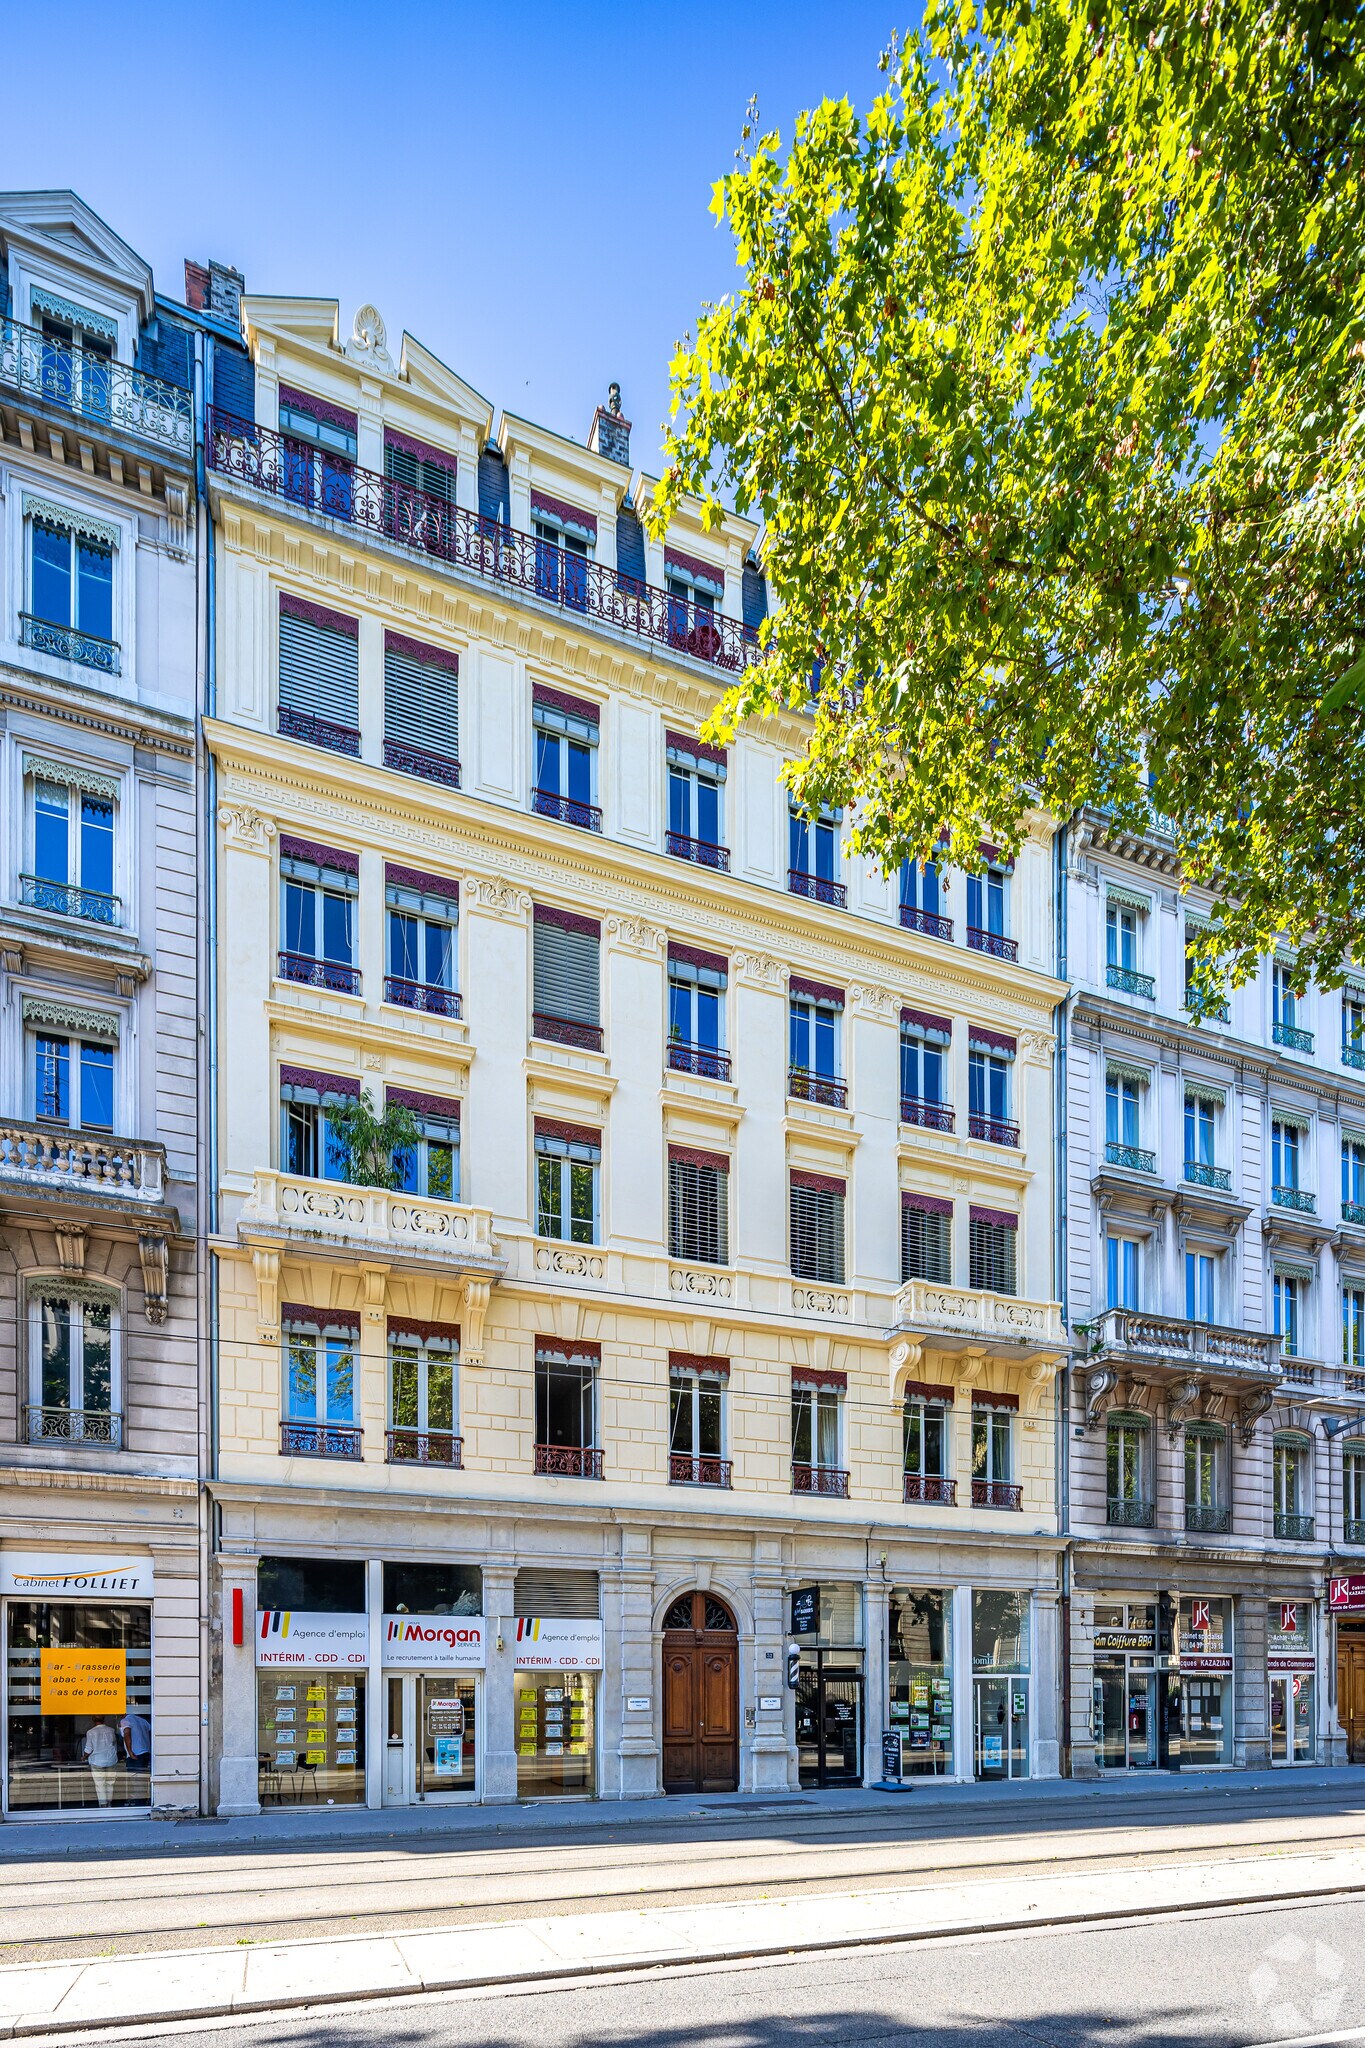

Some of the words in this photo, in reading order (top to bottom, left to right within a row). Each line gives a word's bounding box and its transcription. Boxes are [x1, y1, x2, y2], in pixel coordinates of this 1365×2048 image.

[14, 1577, 59, 1588] Cabinet
[62, 1576, 140, 1590] FOLLIET
[293, 1629, 326, 1639] Agence
[328, 1630, 366, 1640] d'emploi
[404, 1625, 481, 1648] Morgan
[542, 1634, 568, 1642] Agence
[570, 1634, 600, 1643] d'emploi
[1107, 1635, 1137, 1649] Coiffure
[260, 1652, 305, 1662] INTÉRIM
[314, 1653, 338, 1662] CDD
[347, 1654, 366, 1663] CDI
[516, 1656, 552, 1665] INTÉRIM
[559, 1657, 578, 1665] CDD
[585, 1657, 600, 1665] CDI
[47, 1663, 64, 1671] Bar
[74, 1663, 121, 1671] Brasserie
[1200, 1659, 1230, 1667] KAZAZIAN
[1286, 1660, 1315, 1668] Commerces
[48, 1675, 77, 1683] Tabac
[87, 1675, 121, 1683] Presse
[49, 1688, 69, 1696] Pas
[72, 1688, 84, 1696] de
[87, 1688, 118, 1697] portes
